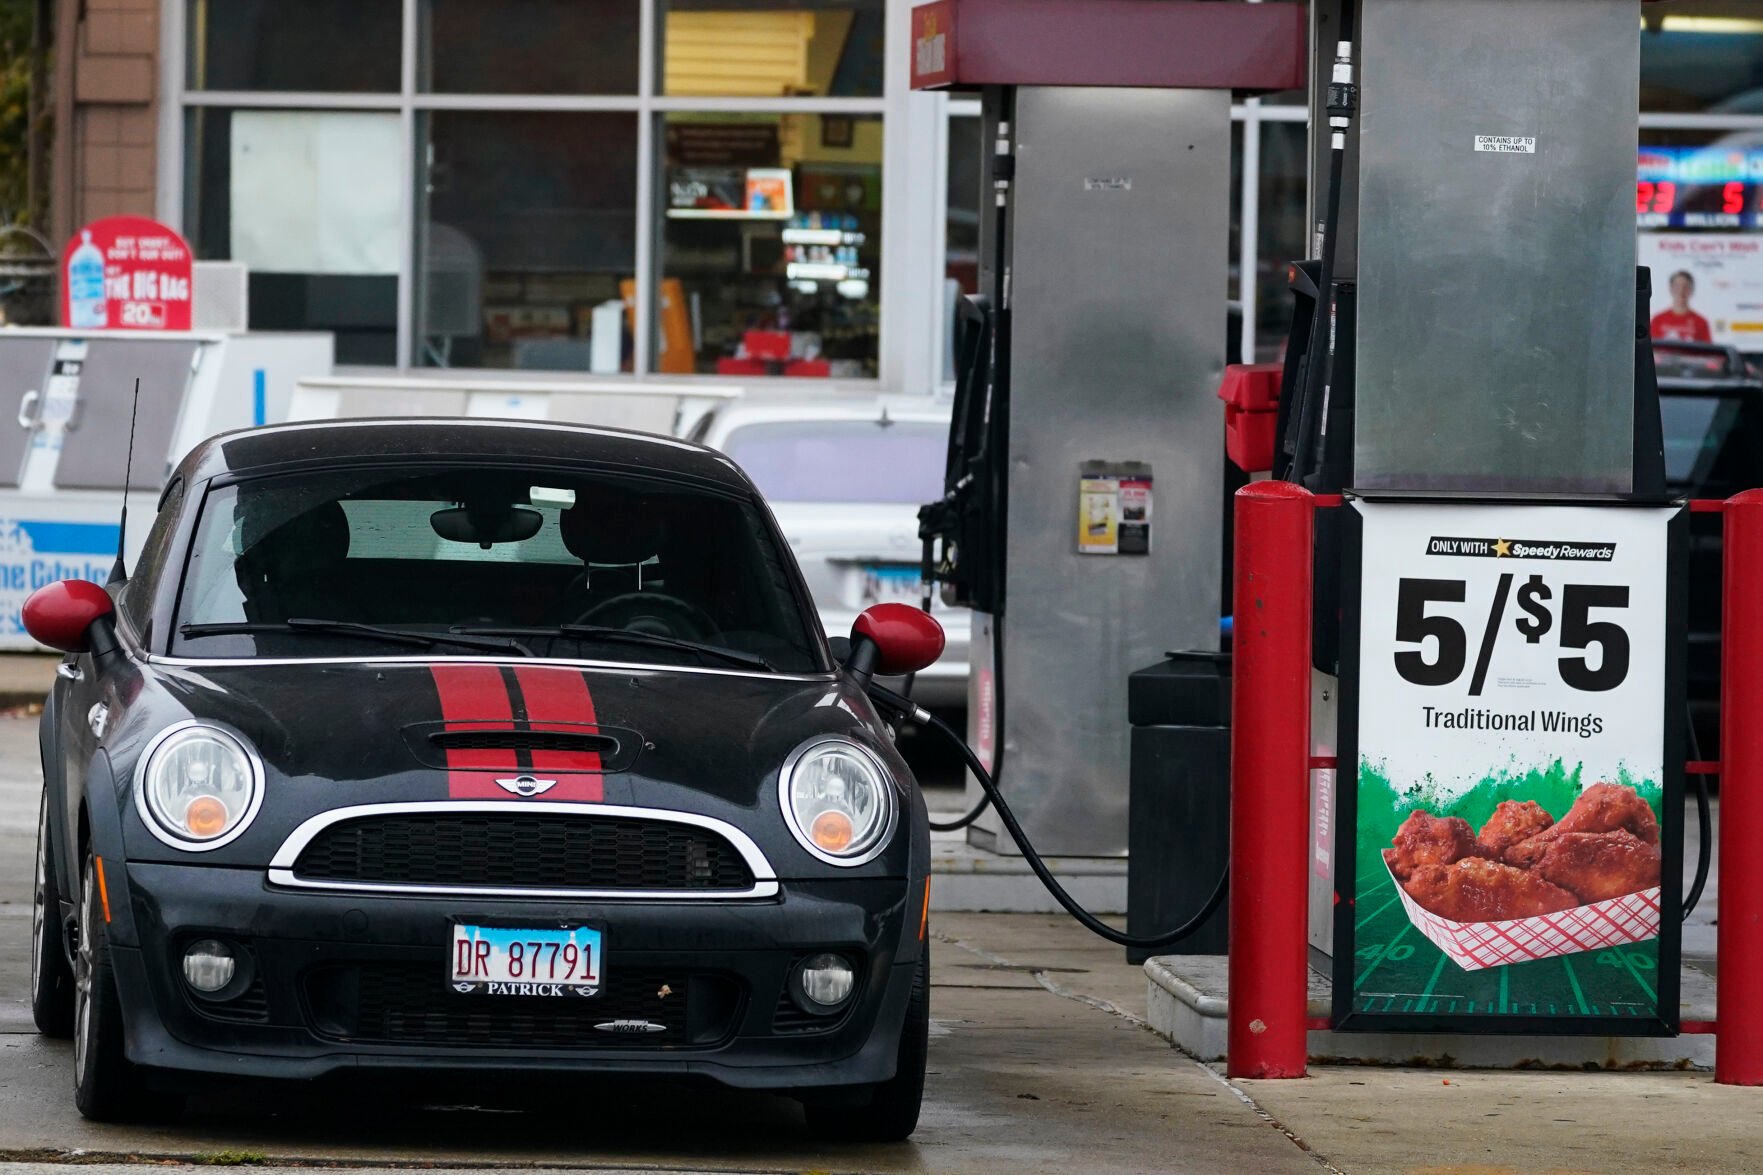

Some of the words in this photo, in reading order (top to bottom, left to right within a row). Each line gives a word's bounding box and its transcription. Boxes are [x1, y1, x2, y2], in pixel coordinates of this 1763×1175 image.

[1479, 136, 1511, 144] CONTAINS
[1498, 144, 1527, 152] ETHANOL
[1722, 181, 1745, 214] 5
[104, 274, 130, 299] THE
[133, 269, 158, 300] BIG
[160, 272, 188, 300] BAG
[1431, 540, 1459, 553] ONLY
[1460, 541, 1488, 554] WITH
[1512, 543, 1560, 559] Speedy
[1559, 545, 1612, 559] Rewards
[1422, 706, 1535, 732] Traditional
[1541, 710, 1603, 739] Wings
[456, 939, 491, 977] DR
[508, 941, 597, 981] 87791
[1355, 944, 1415, 961] 40
[1597, 951, 1656, 969] 40
[487, 983, 564, 997] PATRICK
[614, 1024, 648, 1033] WORKS
